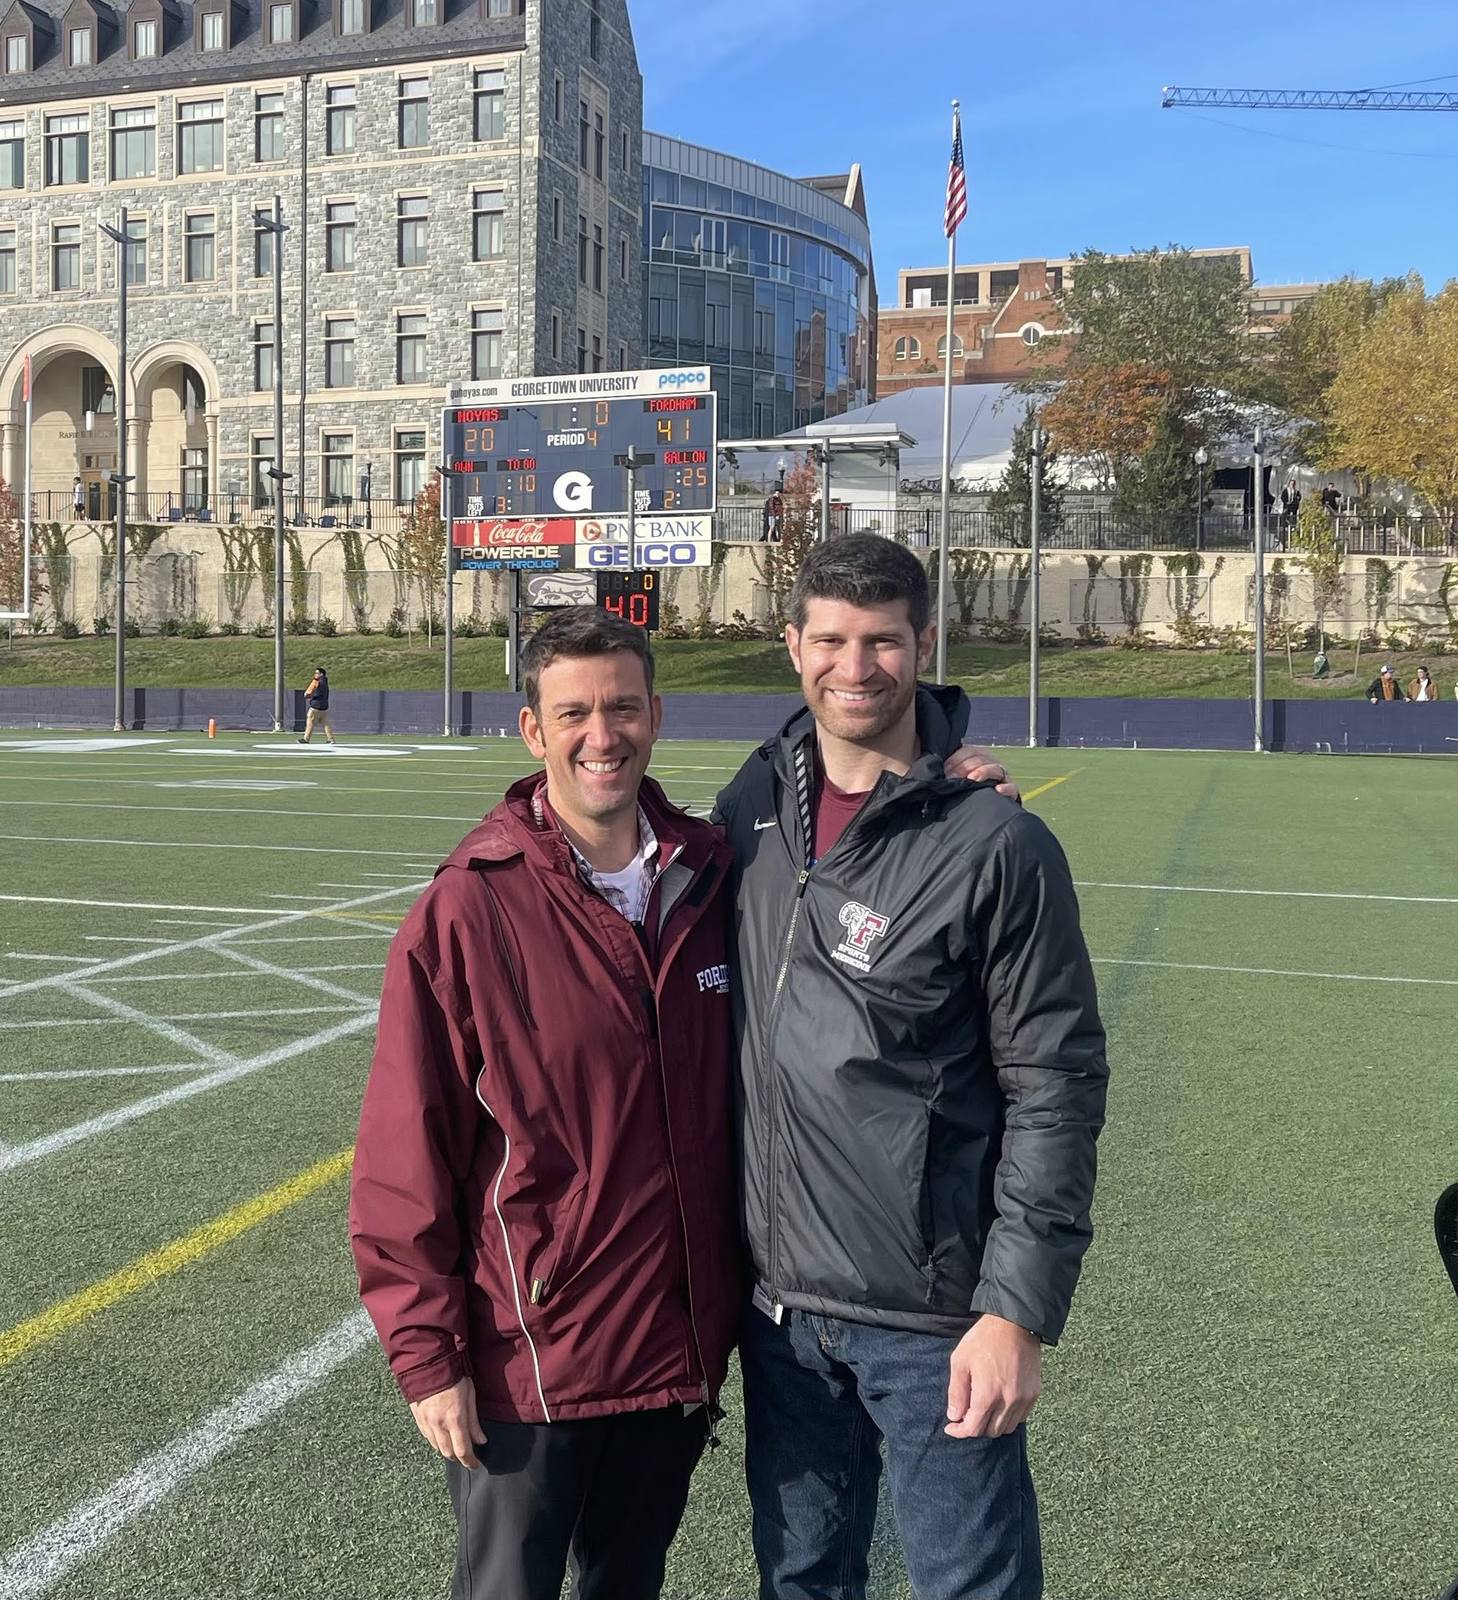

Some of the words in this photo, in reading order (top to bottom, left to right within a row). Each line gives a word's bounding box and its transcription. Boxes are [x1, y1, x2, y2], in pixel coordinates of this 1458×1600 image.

[511, 381, 577, 397] GEORGETOWN
[579, 376, 638, 393] UNIVERSITY
[657, 371, 705, 389] pepco
[649, 397, 697, 412] FORDHAM
[464, 428, 495, 452] 20
[547, 433, 585, 446] PERIOD
[650, 520, 703, 538] BANK
[460, 546, 560, 559] POWERADE
[588, 543, 696, 566] GEICO
[461, 561, 501, 570] POWER
[504, 560, 559, 569] THROUGH
